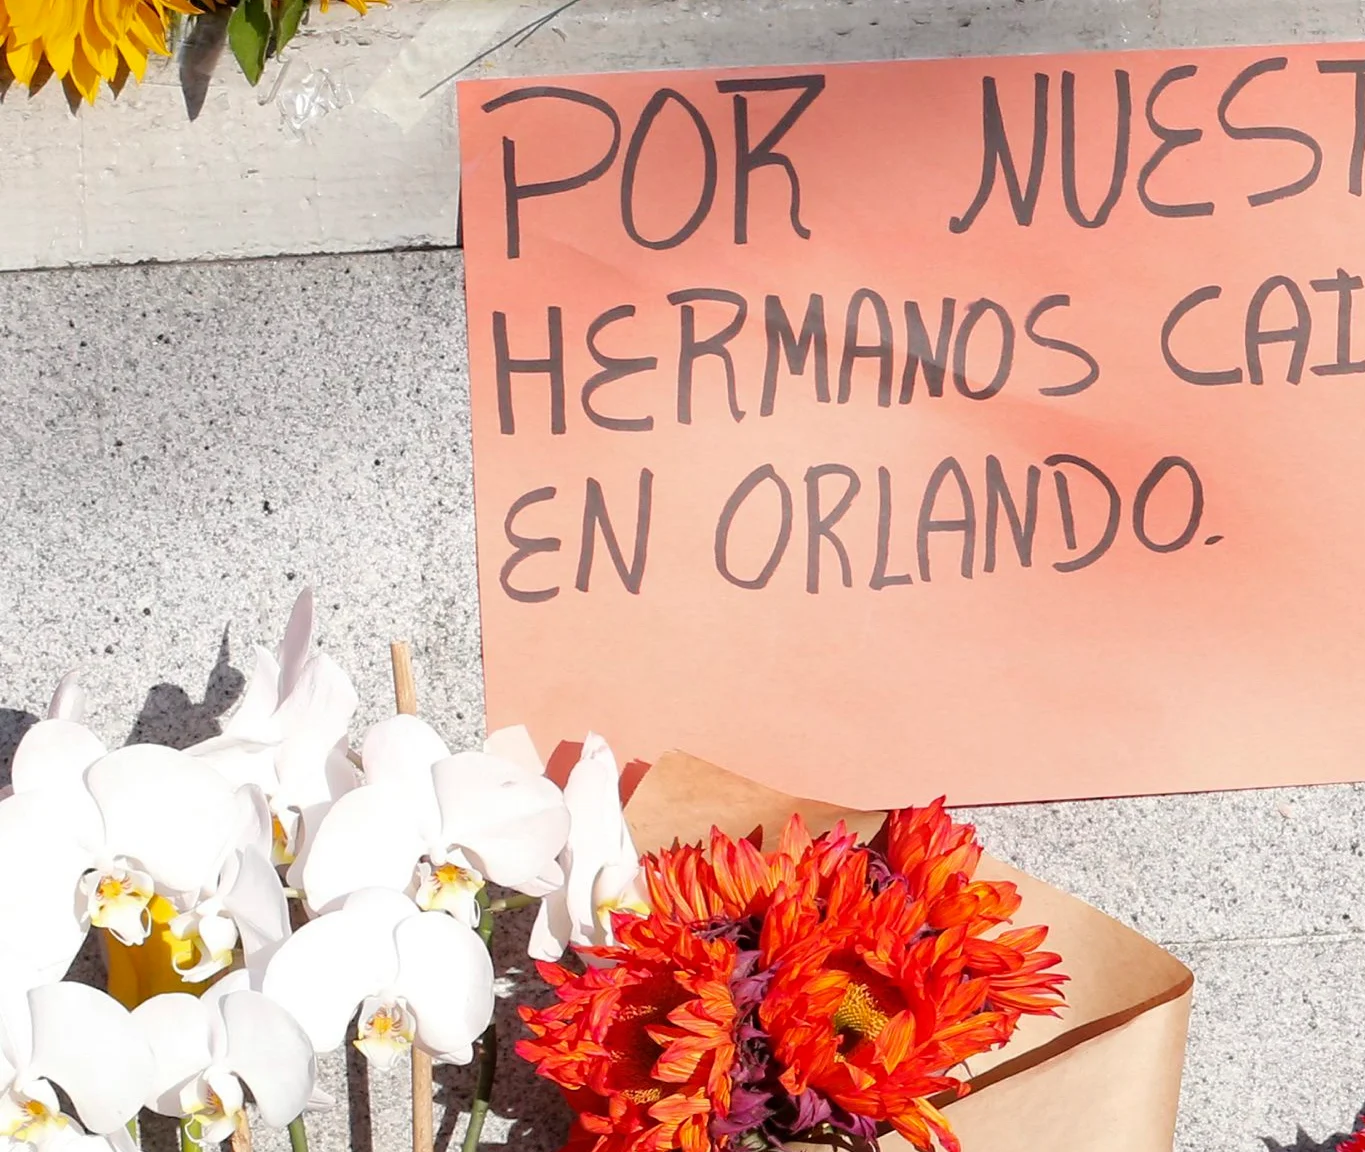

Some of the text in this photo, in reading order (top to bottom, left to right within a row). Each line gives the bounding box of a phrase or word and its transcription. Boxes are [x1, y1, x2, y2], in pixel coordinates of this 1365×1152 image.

[482, 74, 826, 258] POR
[493, 288, 1100, 435] HERMANOS
[499, 454, 1225, 603] EN ORLANDO.
